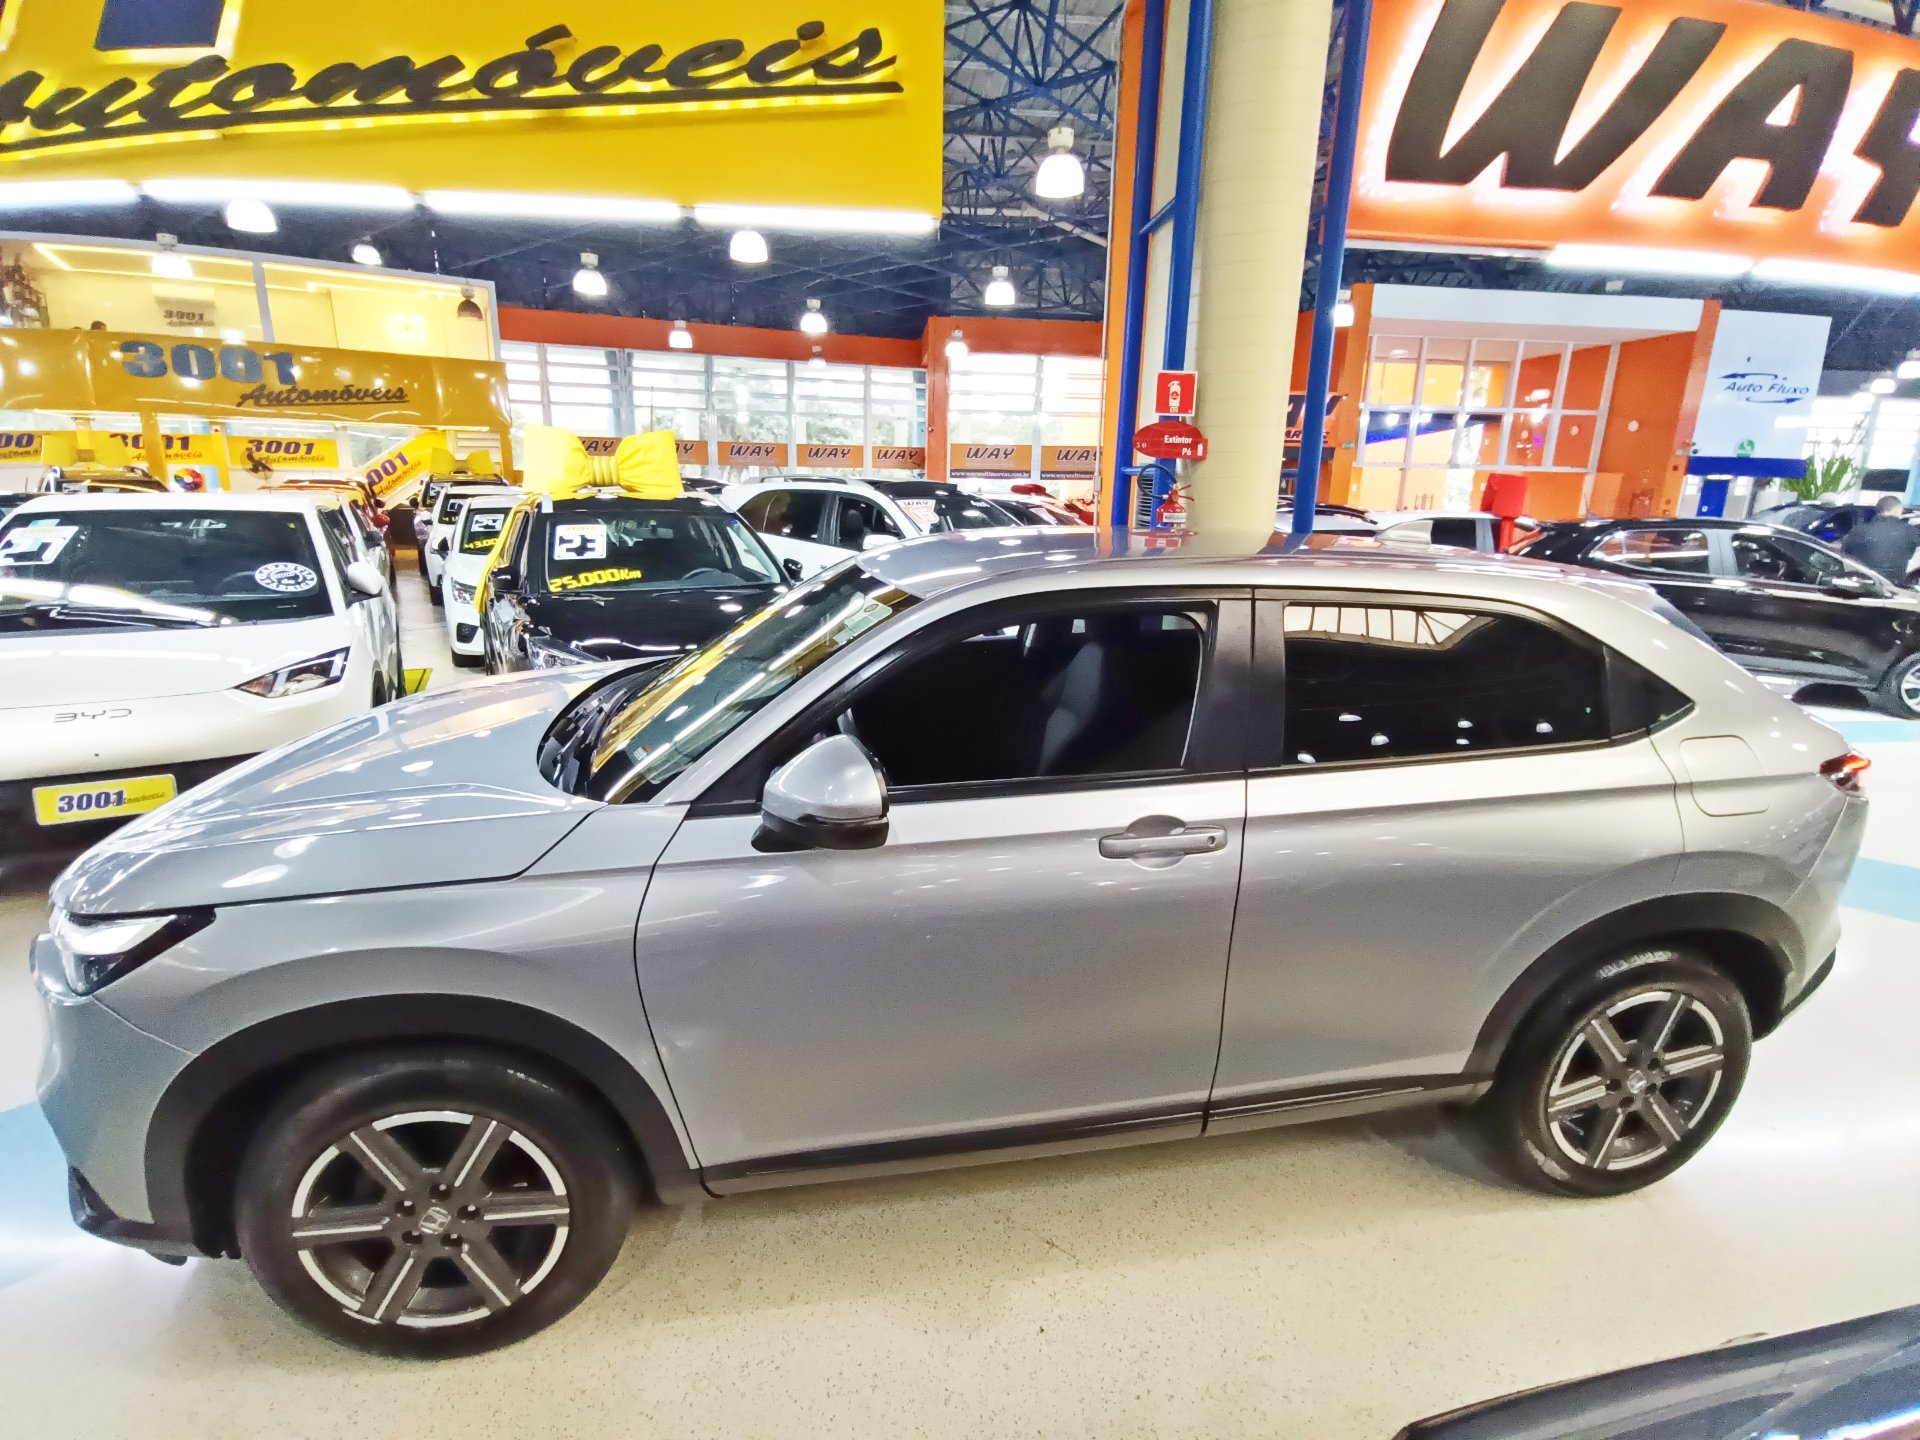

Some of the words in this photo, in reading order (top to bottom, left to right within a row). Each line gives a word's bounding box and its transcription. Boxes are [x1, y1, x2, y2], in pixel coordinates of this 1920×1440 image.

[120, 340, 295, 385] 3001
[236, 382, 407, 407] Automóveis
[1724, 382, 1762, 391] Auto
[1768, 383, 1809, 395] Fluxo
[1164, 435, 1192, 444] Extintor
[248, 439, 314, 455] 3001
[730, 445, 775, 456] WAY
[808, 448, 850, 459] WAY
[966, 447, 1015, 459] WAY
[1182, 447, 1192, 456] P6
[877, 449, 918, 460] WAY
[365, 451, 409, 487] 001
[557, 533, 603, 558] 23
[54, 709, 132, 723] BYD
[58, 790, 125, 813] 3001
